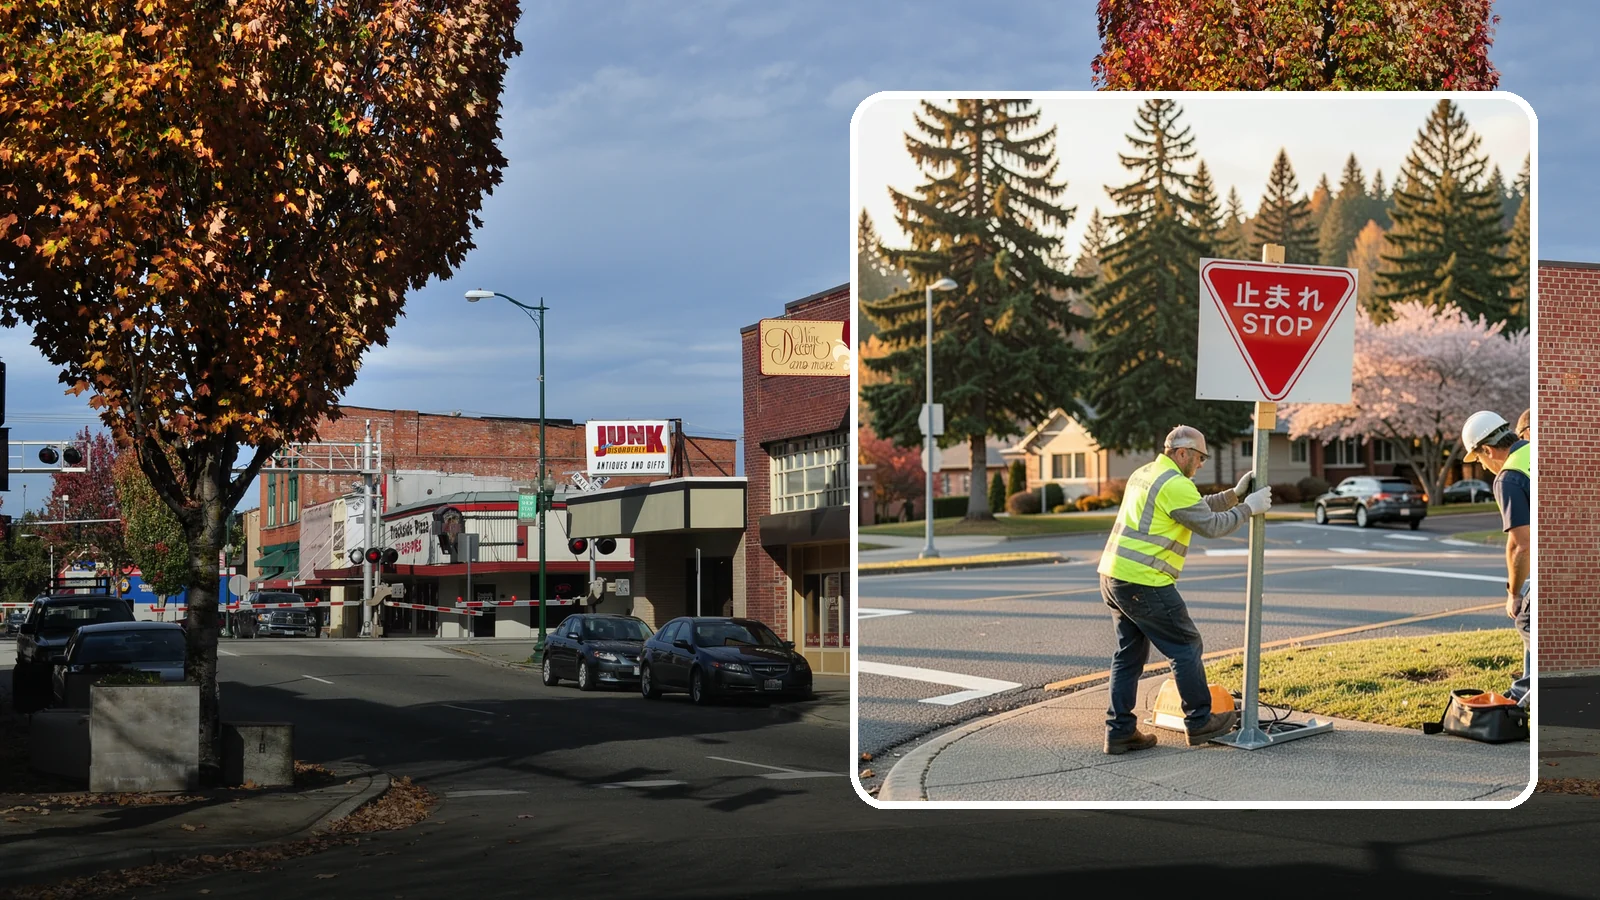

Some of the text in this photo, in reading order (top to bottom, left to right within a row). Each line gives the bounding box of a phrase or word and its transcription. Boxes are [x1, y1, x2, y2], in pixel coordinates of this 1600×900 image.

[1233, 281, 1324, 311] 止まれ
[1242, 313, 1313, 336] STOP
[596, 425, 665, 457] JUNK
[607, 446, 645, 454] DISORDERLY
[597, 461, 665, 470] ANTIQUES AND GIFTS
[415, 520, 429, 535] Pizza
